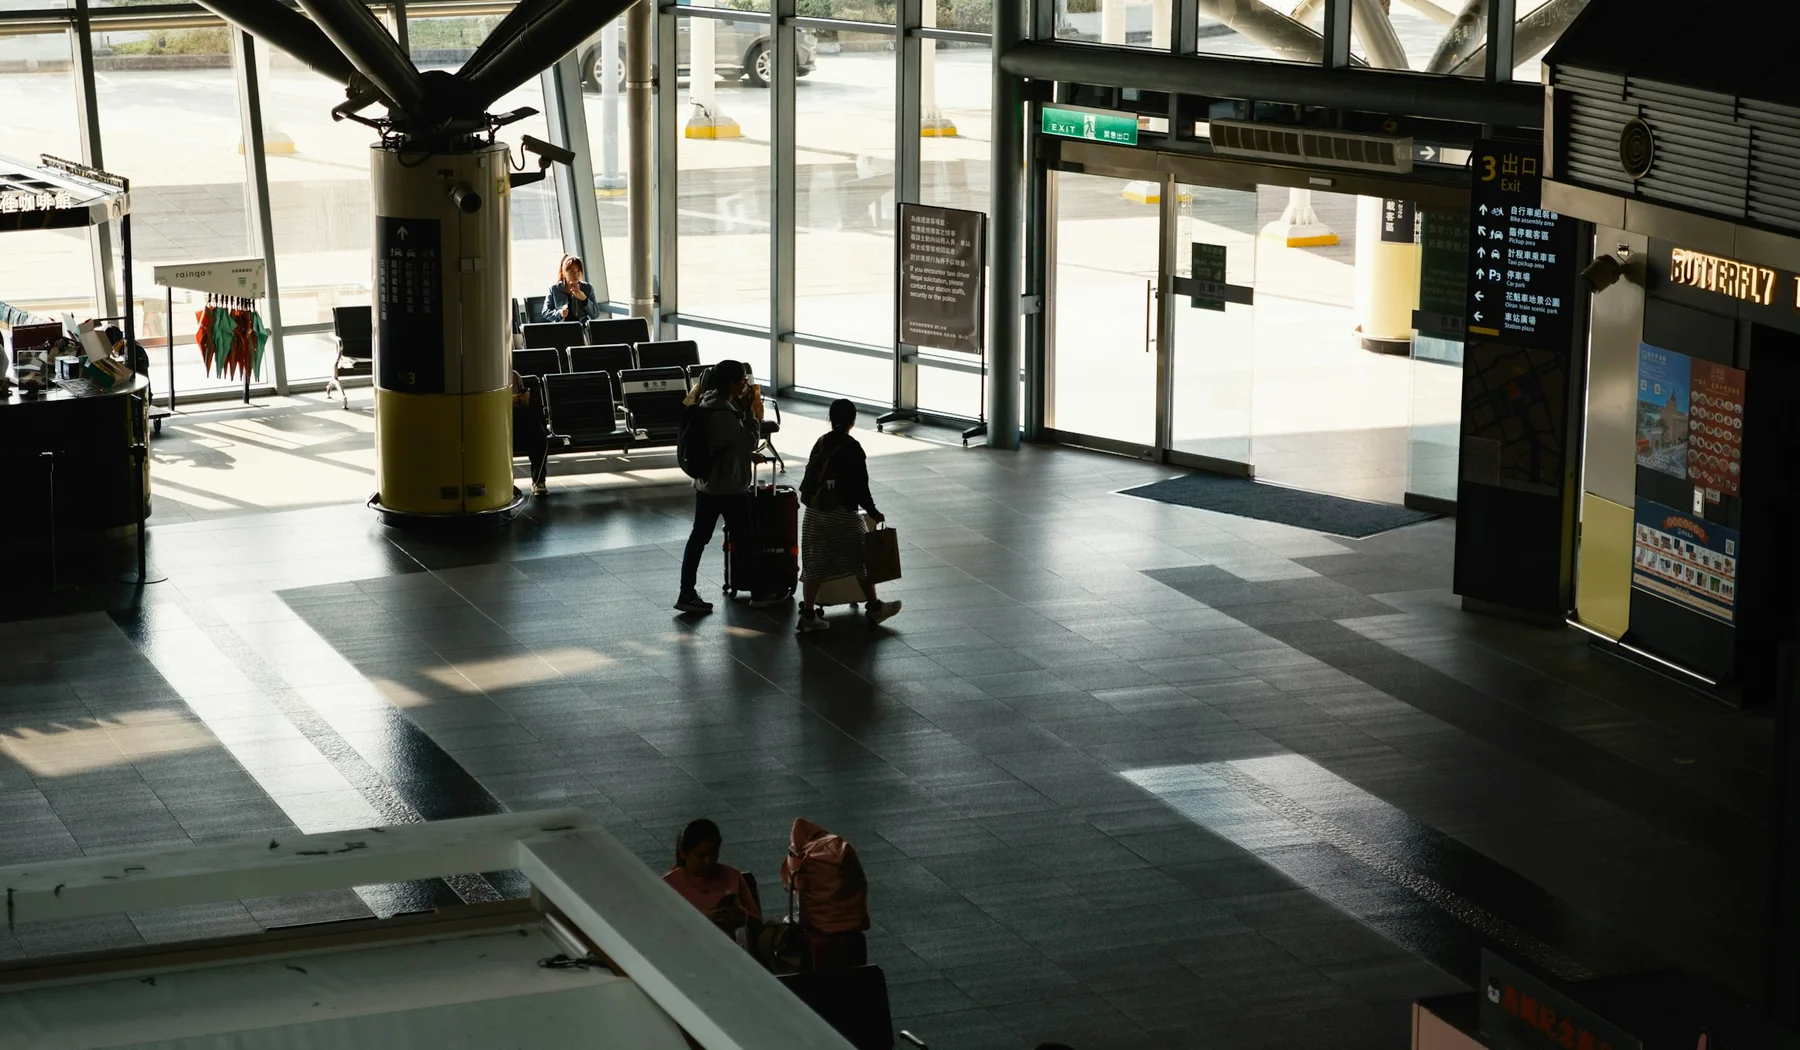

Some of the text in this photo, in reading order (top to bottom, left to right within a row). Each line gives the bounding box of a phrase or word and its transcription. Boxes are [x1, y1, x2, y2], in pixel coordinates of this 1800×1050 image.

[1051, 123, 1076, 134] EXIT
[1103, 129, 1130, 141] 緊急出口
[1481, 152, 1537, 182] 3 出口
[1500, 178, 1522, 193] Exit
[0, 191, 72, 214] 佳咖啡館
[1386, 198, 1396, 232] 載客區
[1509, 215, 1520, 224] Bike
[1520, 217, 1543, 228] assembly
[1508, 238, 1523, 247] Pickup
[1507, 248, 1556, 264] 計程車乘車區
[1507, 258, 1517, 266] Taxi
[1517, 259, 1534, 269] pickup
[914, 266, 923, 274] you
[924, 267, 946, 276] encounter
[947, 269, 956, 277] taxi
[956, 270, 970, 279] driver
[1488, 269, 1502, 282] P3
[1506, 271, 1531, 282] 停車場
[1670, 248, 1776, 306] BUTTERFLY
[910, 274, 923, 282] illegal
[949, 278, 964, 287] please
[1506, 279, 1526, 290] Car park
[910, 282, 926, 290] contact
[935, 285, 951, 293] station
[910, 291, 928, 300] security
[1519, 303, 1530, 311] train
[1531, 305, 1546, 314] scenic
[1546, 307, 1559, 316] park
[1504, 312, 1537, 326] 車站廣場
[1504, 322, 1535, 333] Station plaza
